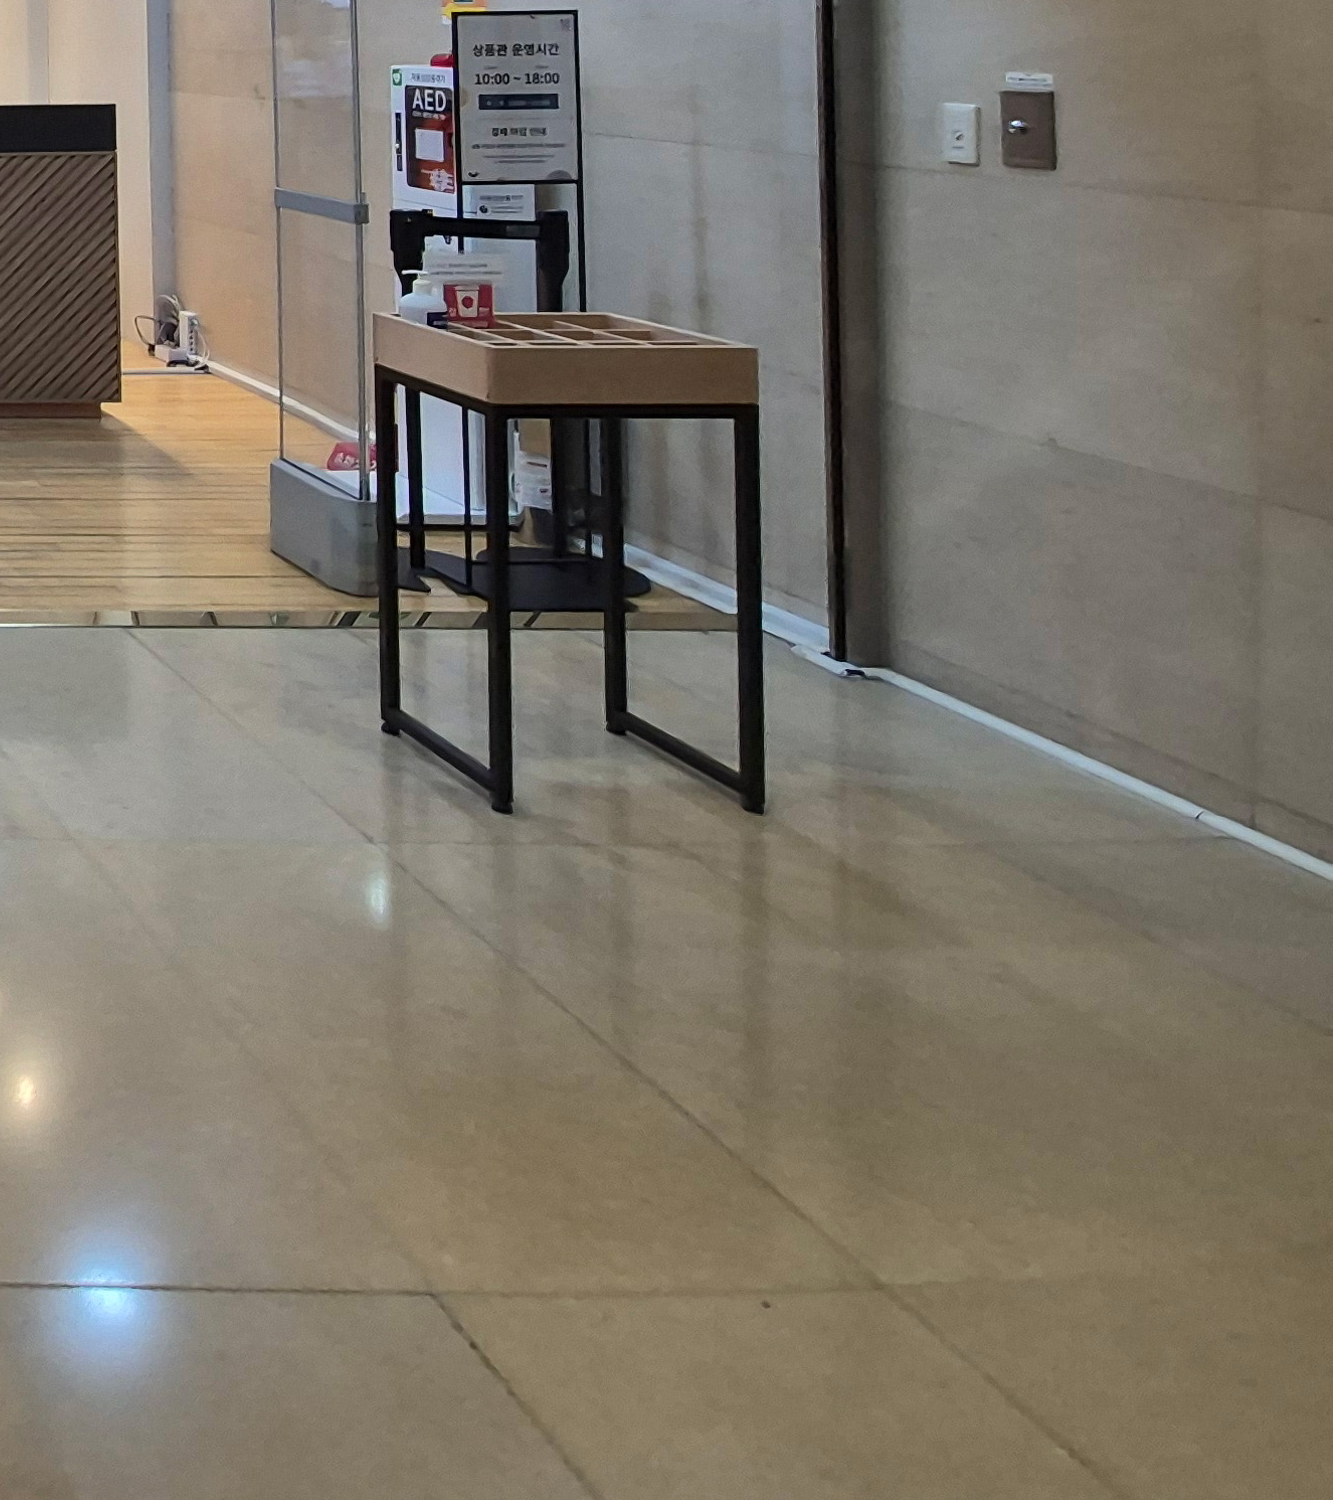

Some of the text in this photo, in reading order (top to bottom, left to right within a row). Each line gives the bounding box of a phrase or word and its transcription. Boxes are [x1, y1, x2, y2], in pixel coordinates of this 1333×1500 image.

[472, 43, 560, 57] 상품관 운영시간
[475, 73, 510, 85] 10:00
[525, 72, 560, 84] 18:00
[412, 88, 447, 112] AED
